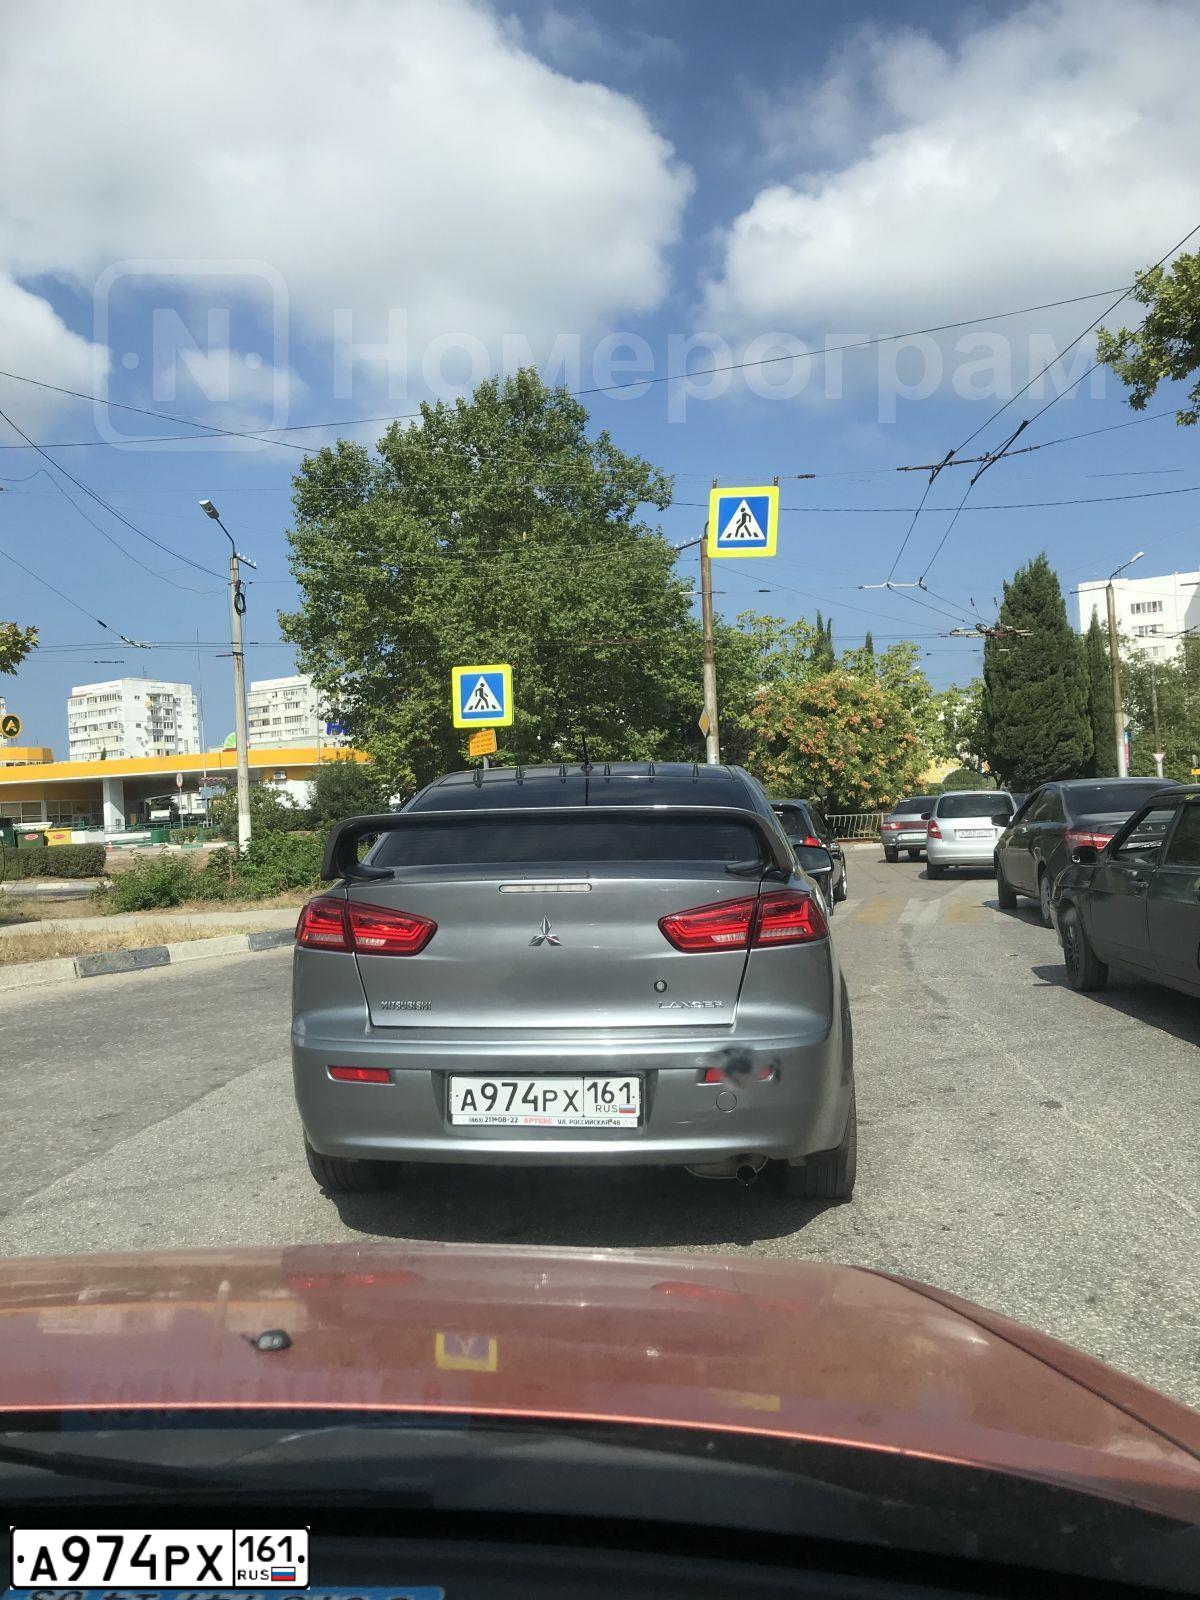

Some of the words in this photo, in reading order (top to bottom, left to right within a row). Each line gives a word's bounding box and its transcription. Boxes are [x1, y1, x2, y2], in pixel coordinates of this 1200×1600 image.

[380, 1000, 432, 1010] MITSUBISHI
[658, 1000, 724, 1009] LANCER
[460, 1082, 579, 1112] А974РХ
[586, 1081, 631, 1104] 161
[595, 1105, 618, 1113] RUS
